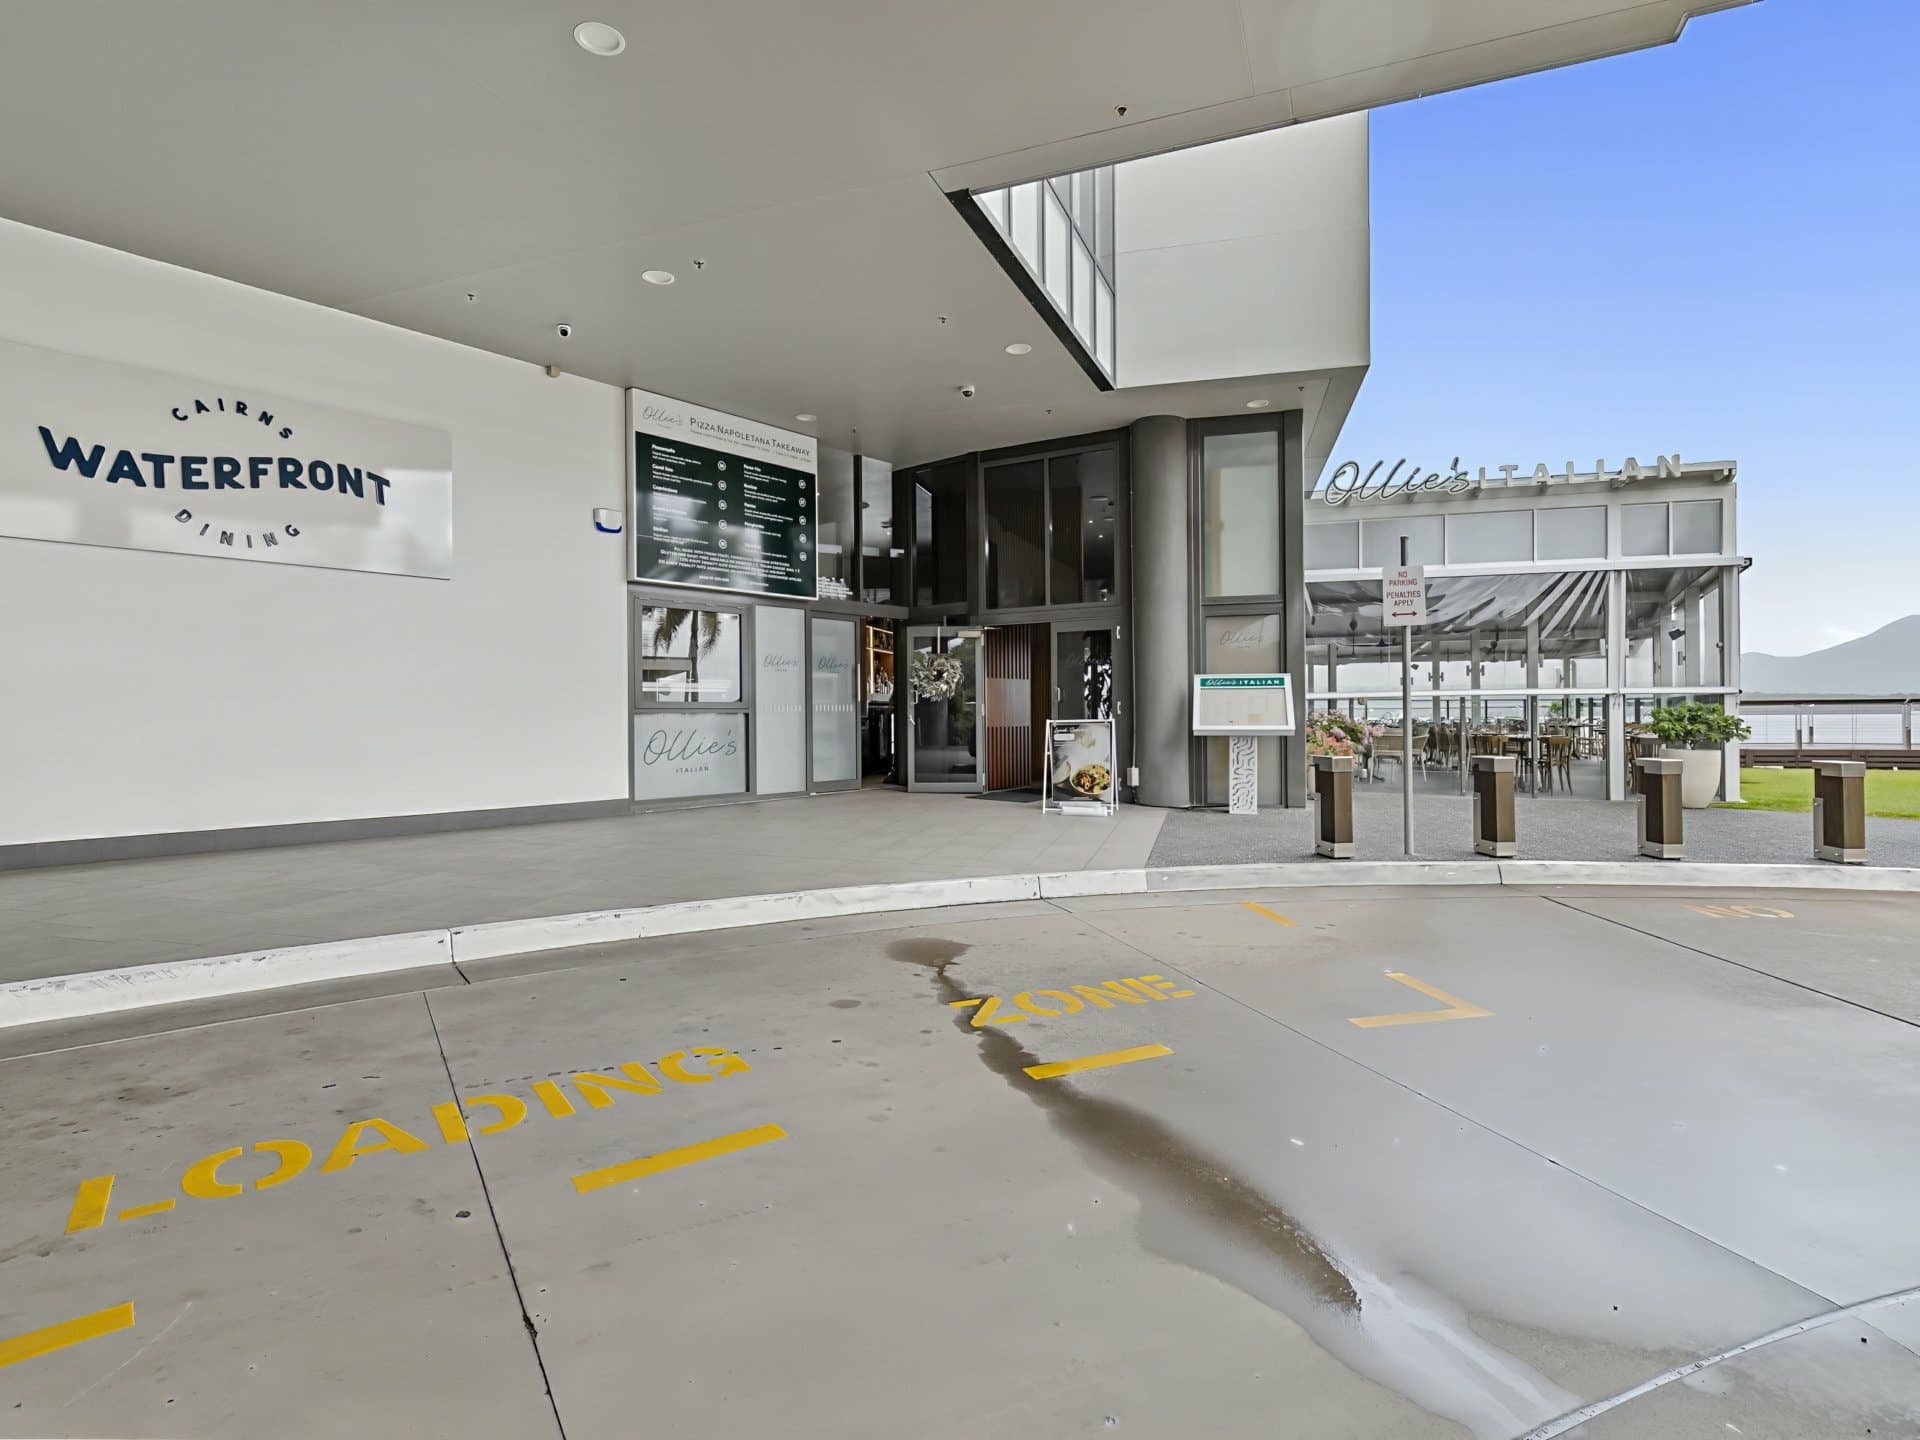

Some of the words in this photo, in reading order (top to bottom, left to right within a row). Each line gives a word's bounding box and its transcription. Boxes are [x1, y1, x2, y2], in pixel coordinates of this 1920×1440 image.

[171, 398, 293, 439] CAIRNS
[689, 417, 716, 433] PIZZA
[717, 424, 771, 446] NAPOLETANA
[772, 438, 811, 457] TAKEAWAY
[38, 426, 391, 505] WATERFRONT
[1324, 456, 1470, 506] Ollie's
[1478, 453, 1682, 489] ITALIAN
[174, 508, 301, 548] DINING
[1386, 590, 1422, 600] PENALTIES
[1388, 578, 1418, 587] PARKING
[1393, 599, 1414, 607] APPLY
[643, 729, 737, 766] Ollie's
[674, 766, 710, 774] ITALIAN
[65, 1046, 751, 1236] LOADING
[948, 974, 1196, 1028] ZONE
